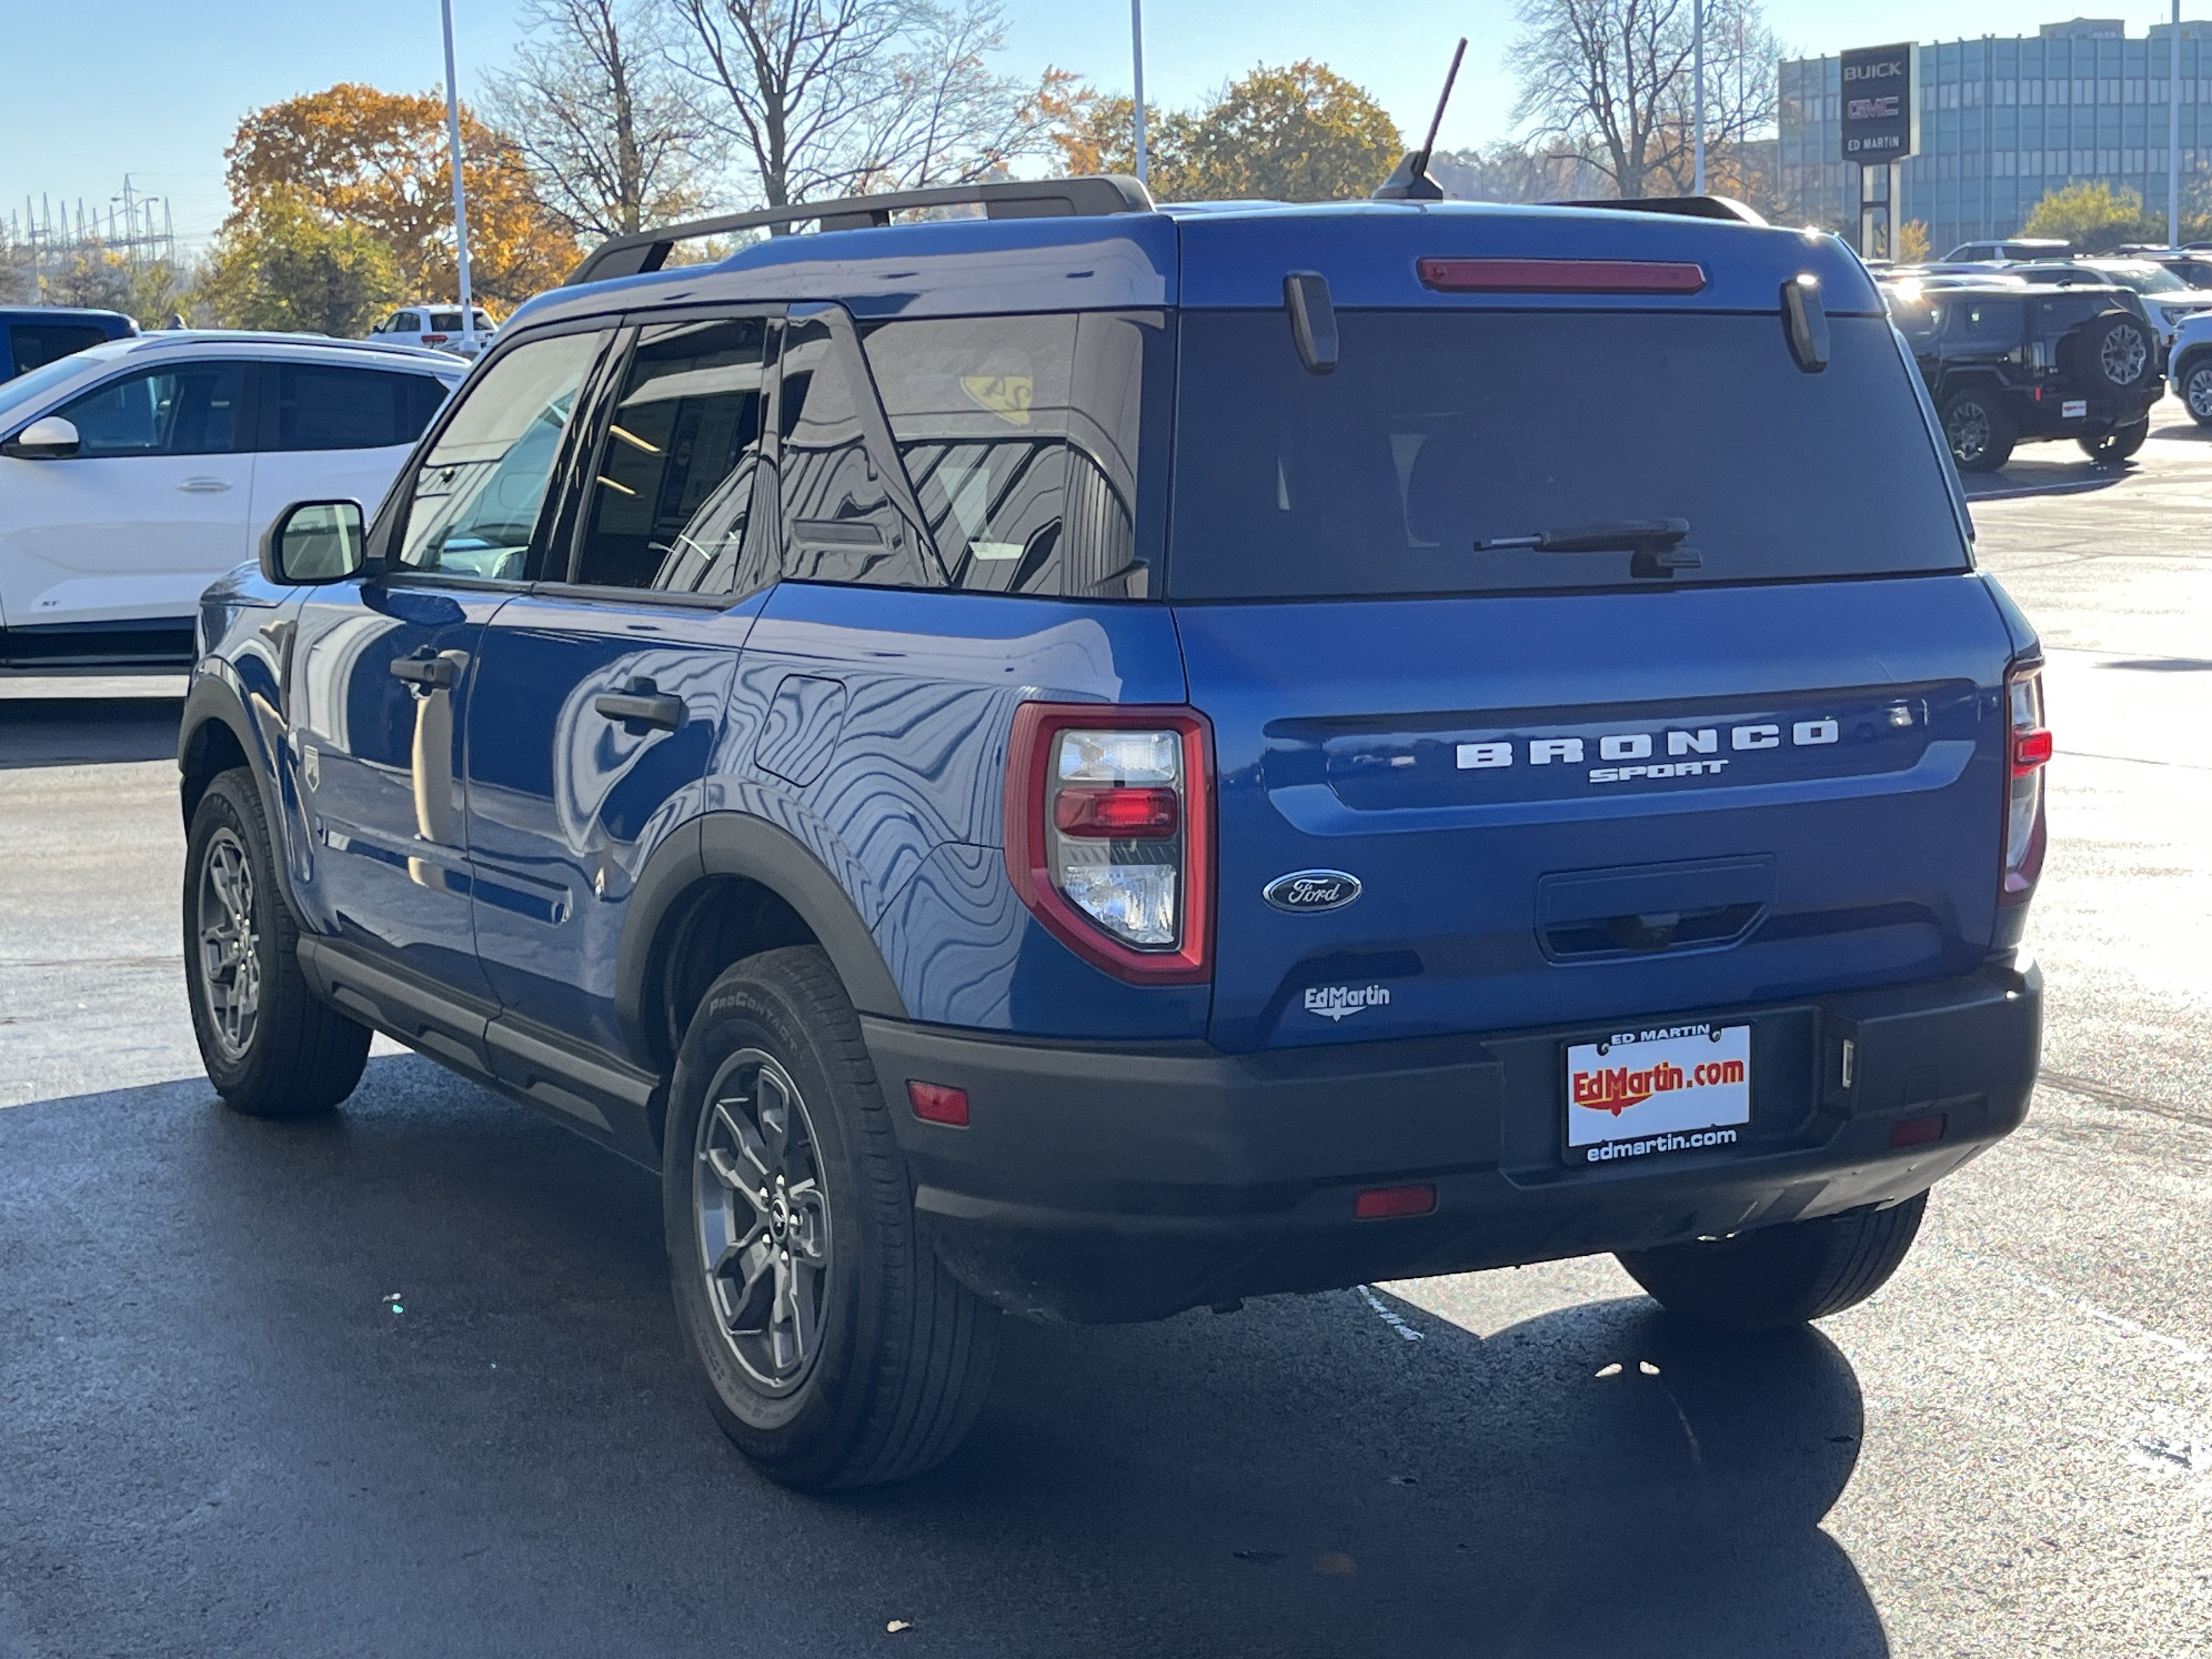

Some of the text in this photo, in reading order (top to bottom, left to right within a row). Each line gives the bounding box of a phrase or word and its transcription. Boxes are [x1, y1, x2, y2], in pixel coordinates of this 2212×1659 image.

[1844, 61, 1902, 82] BUICK
[1847, 97, 1899, 120] GMC
[1847, 137, 1899, 151] ED MARTIN
[1456, 719, 1839, 769] BRONCO
[1589, 759, 1729, 783] SPORT
[1288, 878, 1341, 903] Ford
[1304, 985, 1390, 1009] EdMartin
[1611, 1023, 1711, 1046] ED MARTIN
[1573, 1059, 1744, 1104] EdMartin.com
[1587, 1128, 1737, 1163] edmartin.com
